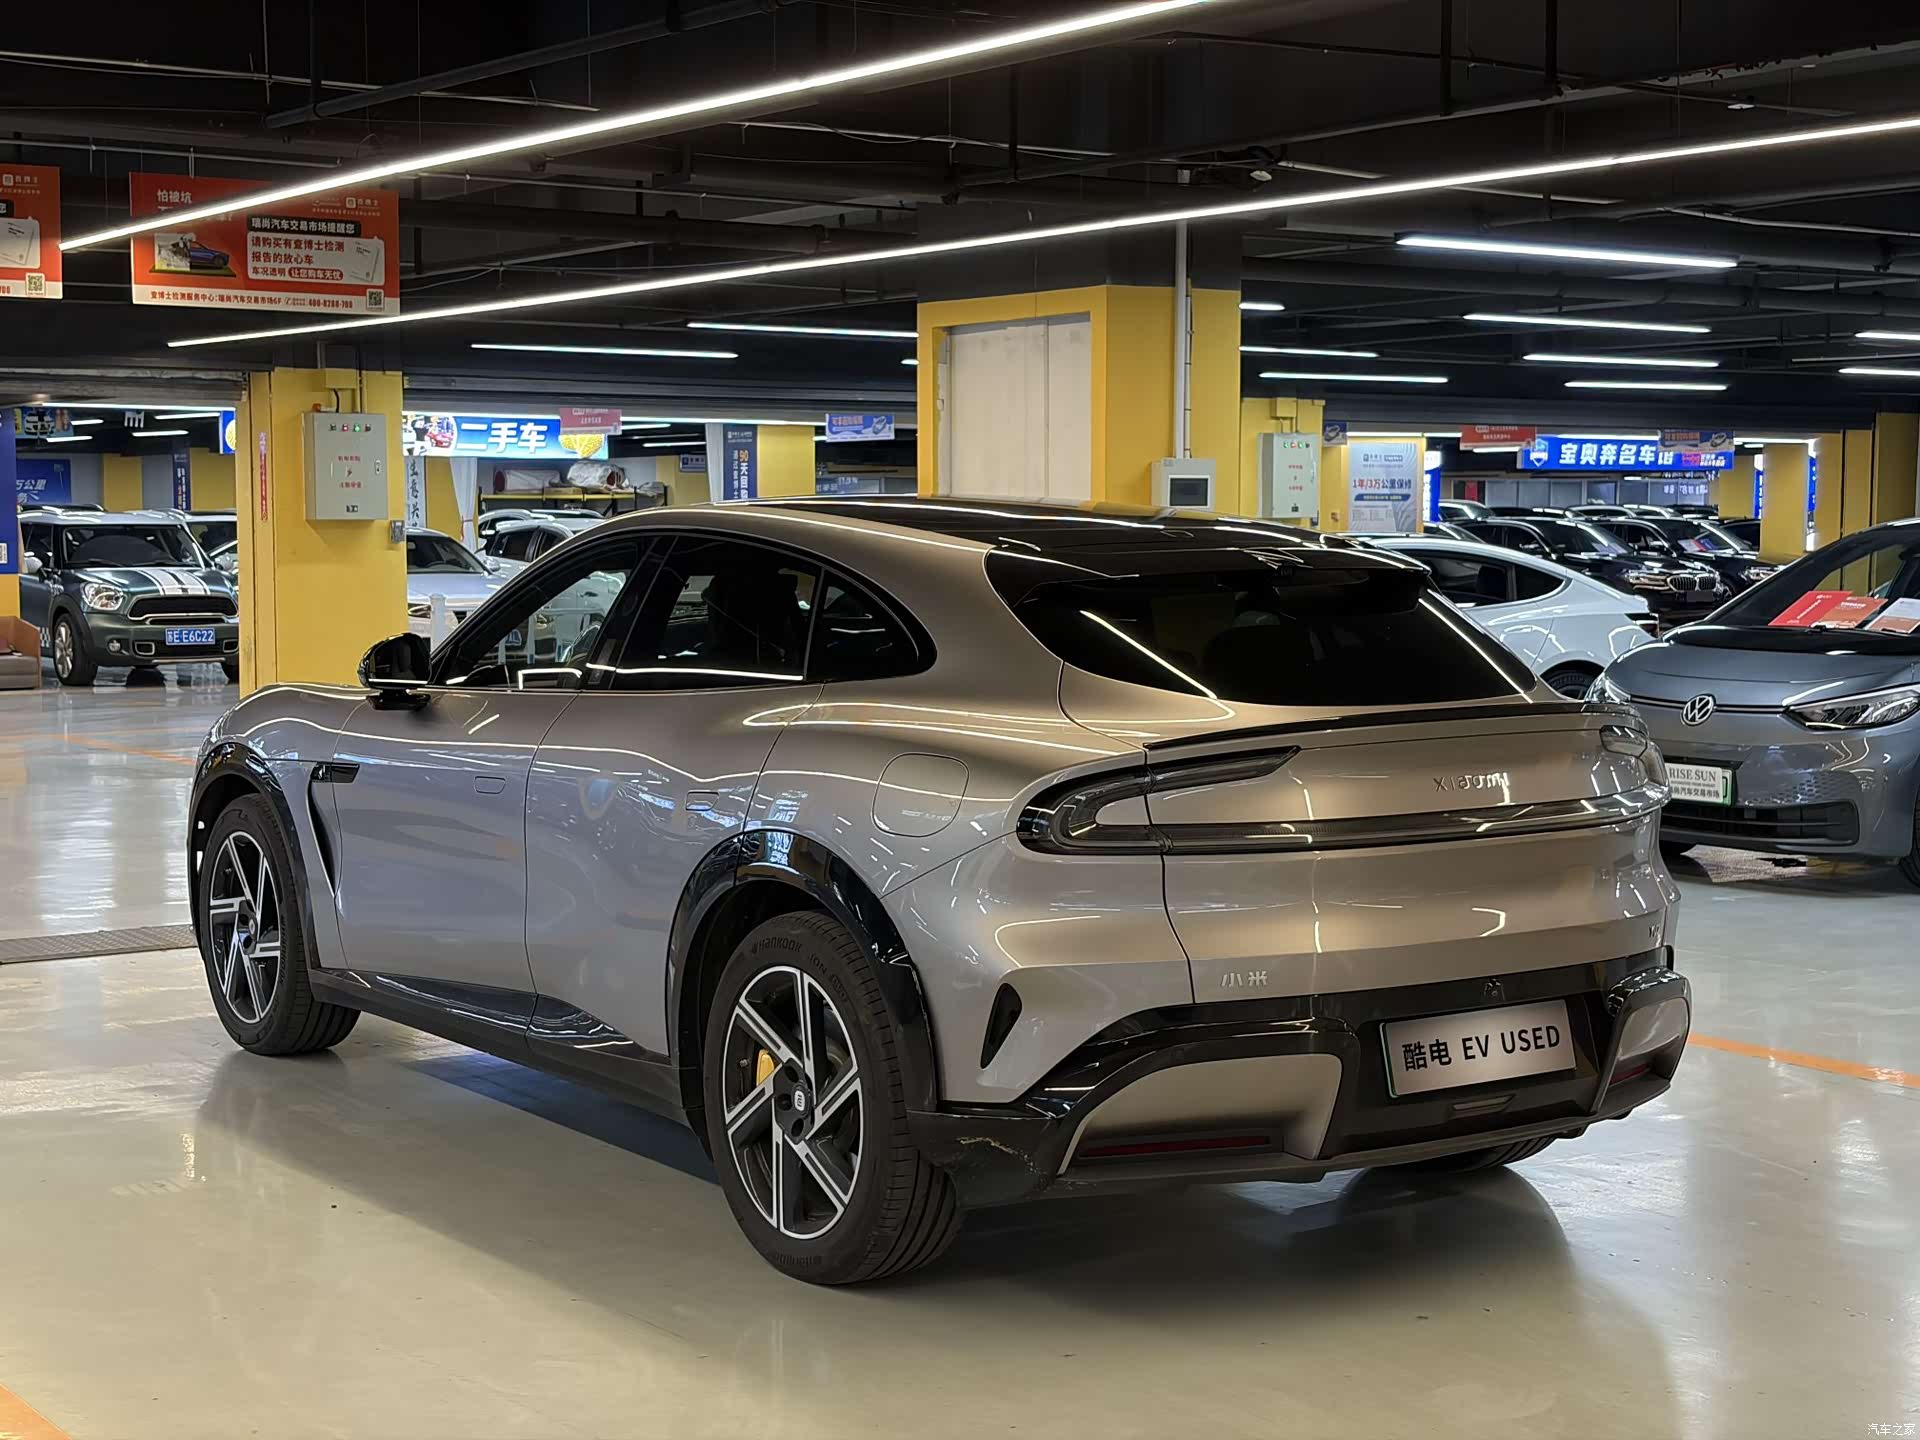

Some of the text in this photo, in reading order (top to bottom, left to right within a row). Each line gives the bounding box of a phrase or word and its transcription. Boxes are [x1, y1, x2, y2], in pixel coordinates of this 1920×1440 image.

[157, 188, 193, 204] 怕被坑
[251, 217, 355, 236] 瑞尚汽车交易市场提醒您
[251, 236, 346, 253] 请购买有查博士检测
[251, 251, 314, 266] 报告的放心车
[251, 266, 287, 278] 车况透明
[455, 421, 548, 454] 二手车
[1559, 443, 1674, 466] 宝奥奔名车馆
[1668, 767, 1717, 782] RISE SUN
[1220, 970, 1268, 988] 小米
[1401, 1025, 1560, 1072] 酷电 EV USED
